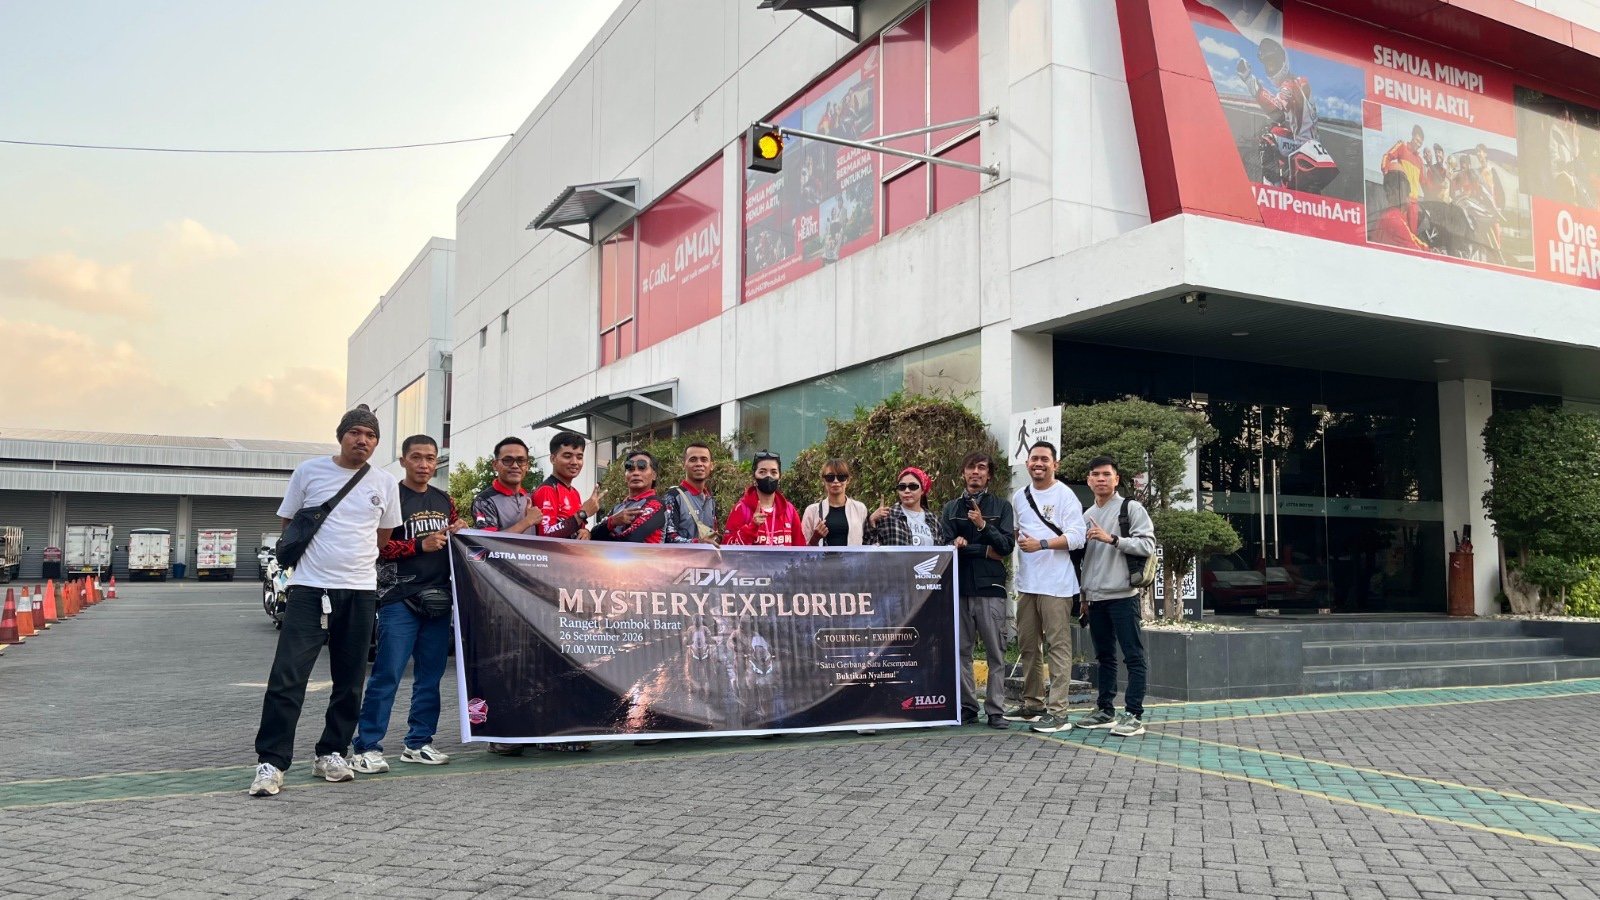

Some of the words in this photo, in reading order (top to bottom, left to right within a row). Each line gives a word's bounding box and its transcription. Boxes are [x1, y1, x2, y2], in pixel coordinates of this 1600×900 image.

[1373, 44, 1433, 80] SEMUA
[1435, 62, 1484, 94] MIMPI
[1373, 74, 1432, 109] PENUH
[1434, 92, 1475, 123] ARTI,
[1557, 209, 1598, 249] One
[1035, 417, 1050, 425] JALUR
[1031, 426, 1053, 434] PEJALAN
[488, 551, 517, 560] ASTRA
[517, 553, 548, 562] MOTOR
[558, 587, 710, 617] MYSTERY
[720, 592, 875, 618] EXPLORIDE
[605, 618, 650, 630] Lombok
[653, 619, 682, 630] Barat
[559, 630, 571, 640] 26
[573, 631, 620, 643] September
[622, 632, 644, 642] 2026
[823, 634, 861, 643] TOURING
[872, 632, 913, 642] EXHIBITION
[560, 644, 585, 654] 17.00
[586, 645, 617, 655] WITA
[836, 661, 866, 670] Gerbang
[866, 660, 881, 668] Satu
[882, 660, 918, 669] Kesempatan
[835, 672, 867, 680] Buktikan
[914, 694, 947, 706] HALO
